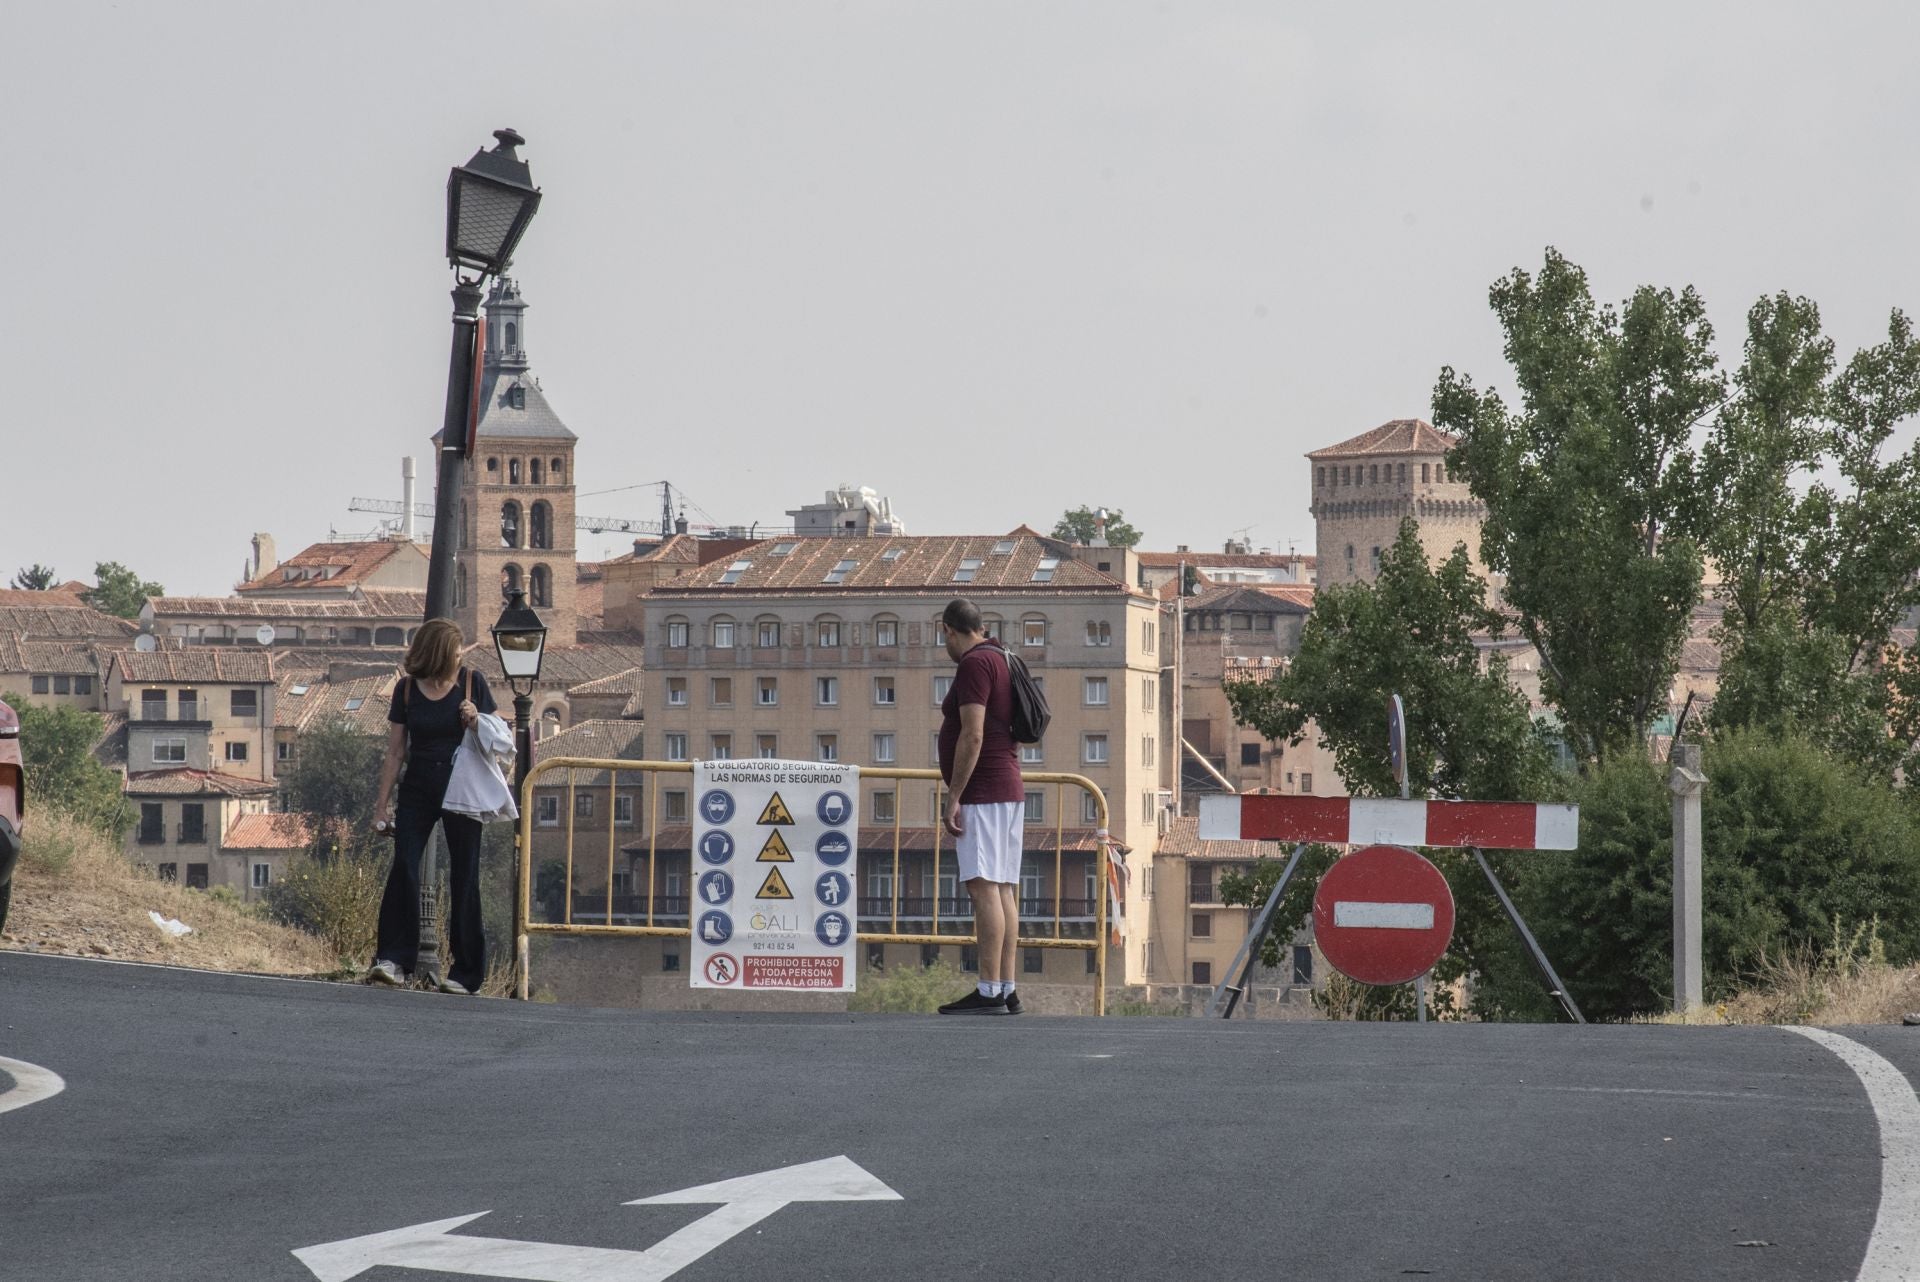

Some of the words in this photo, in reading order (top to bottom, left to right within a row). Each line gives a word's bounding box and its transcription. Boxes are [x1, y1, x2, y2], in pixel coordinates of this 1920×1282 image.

[718, 762, 780, 771] OBLIGATORIO
[782, 763, 817, 771] SEGUIR
[711, 773, 729, 783] LAS
[732, 773, 772, 783] NORMAS
[773, 774, 786, 783] DE
[788, 774, 842, 784] SEGURIDAD
[750, 912, 799, 931] GALI
[753, 942, 765, 950] 921
[747, 958, 799, 967] PROHIBIDO
[801, 958, 812, 967] EL
[814, 959, 840, 967] PASO
[753, 968, 760, 977] A
[761, 968, 787, 977] TODA
[788, 968, 833, 977] PERSONA
[752, 978, 784, 986] AJENA
[784, 978, 792, 986] A
[793, 978, 805, 986] LA
[806, 978, 834, 987] OBRA
